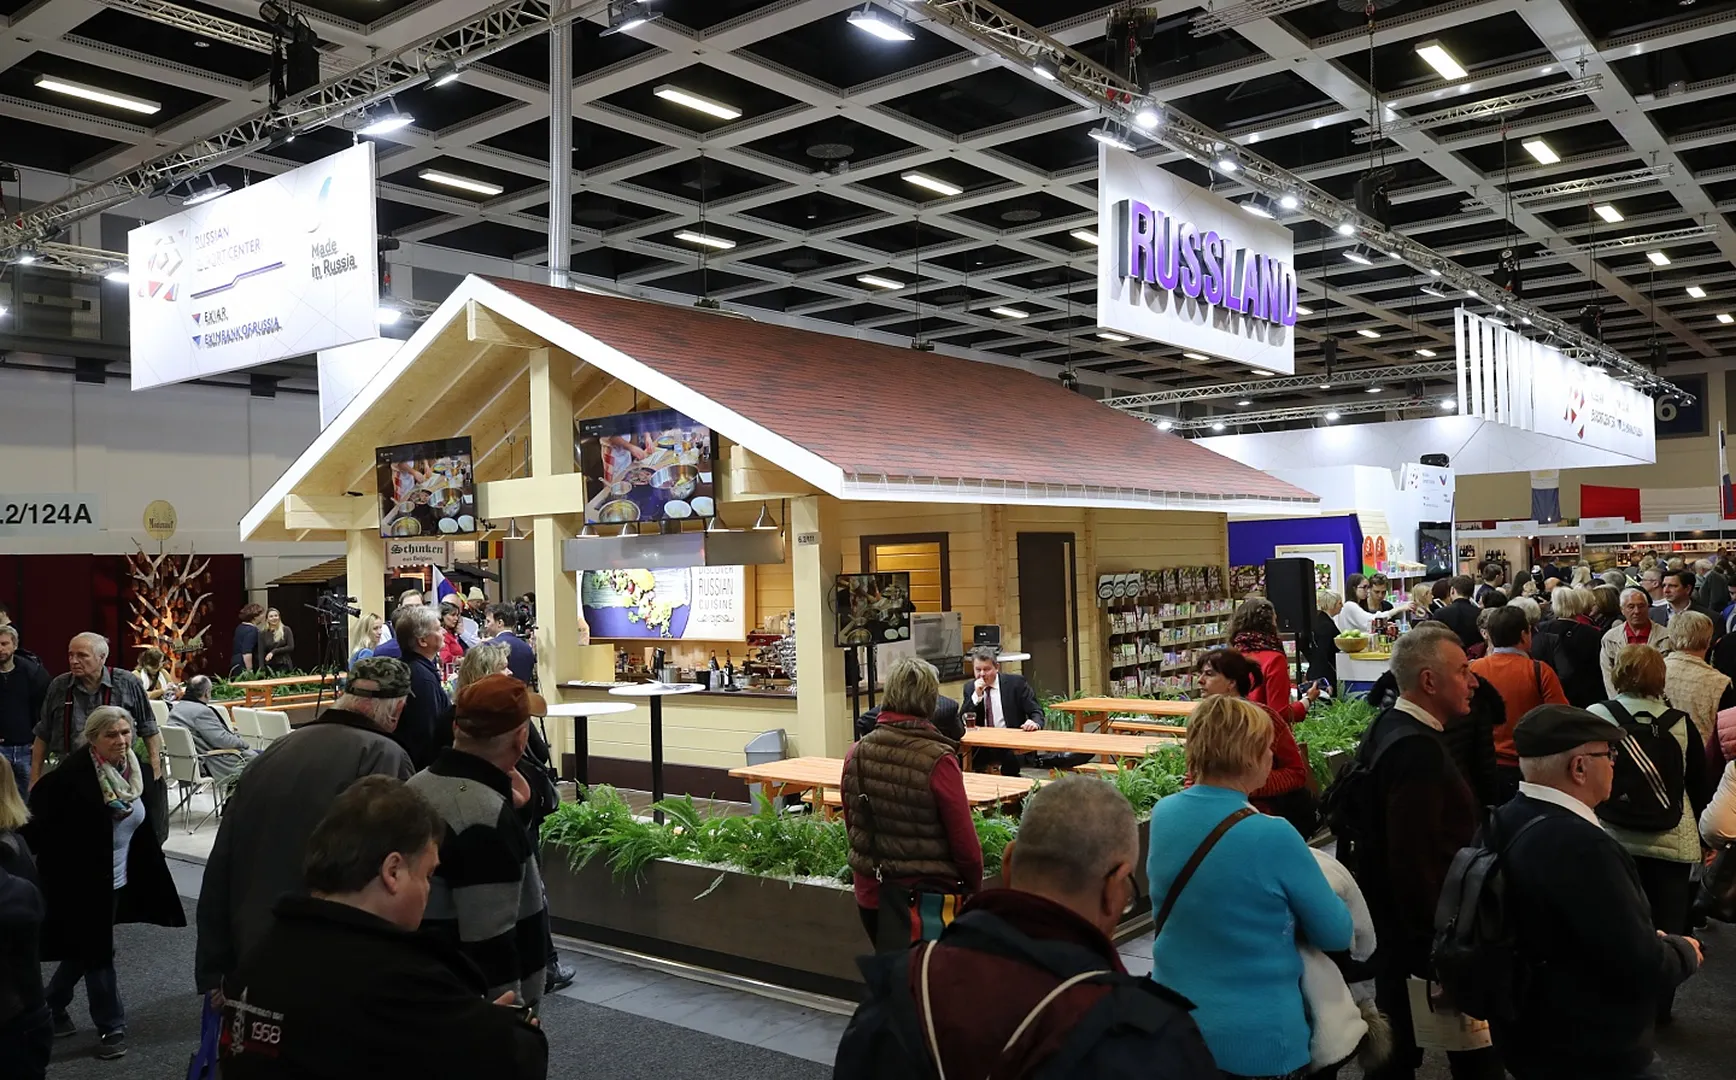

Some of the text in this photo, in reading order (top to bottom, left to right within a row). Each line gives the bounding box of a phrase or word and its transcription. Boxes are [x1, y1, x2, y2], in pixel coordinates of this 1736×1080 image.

[195, 226, 229, 250] RUSSIAN
[311, 237, 337, 258] Made
[227, 238, 261, 260] CENTER
[311, 252, 355, 278] in Russia
[1122, 198, 1297, 327] RUSSLAND
[252, 316, 281, 333] RUSSIA
[391, 544, 443, 555] Schinken
[698, 577, 734, 597] RUSSIAN
[698, 598, 733, 610] CUISINE
